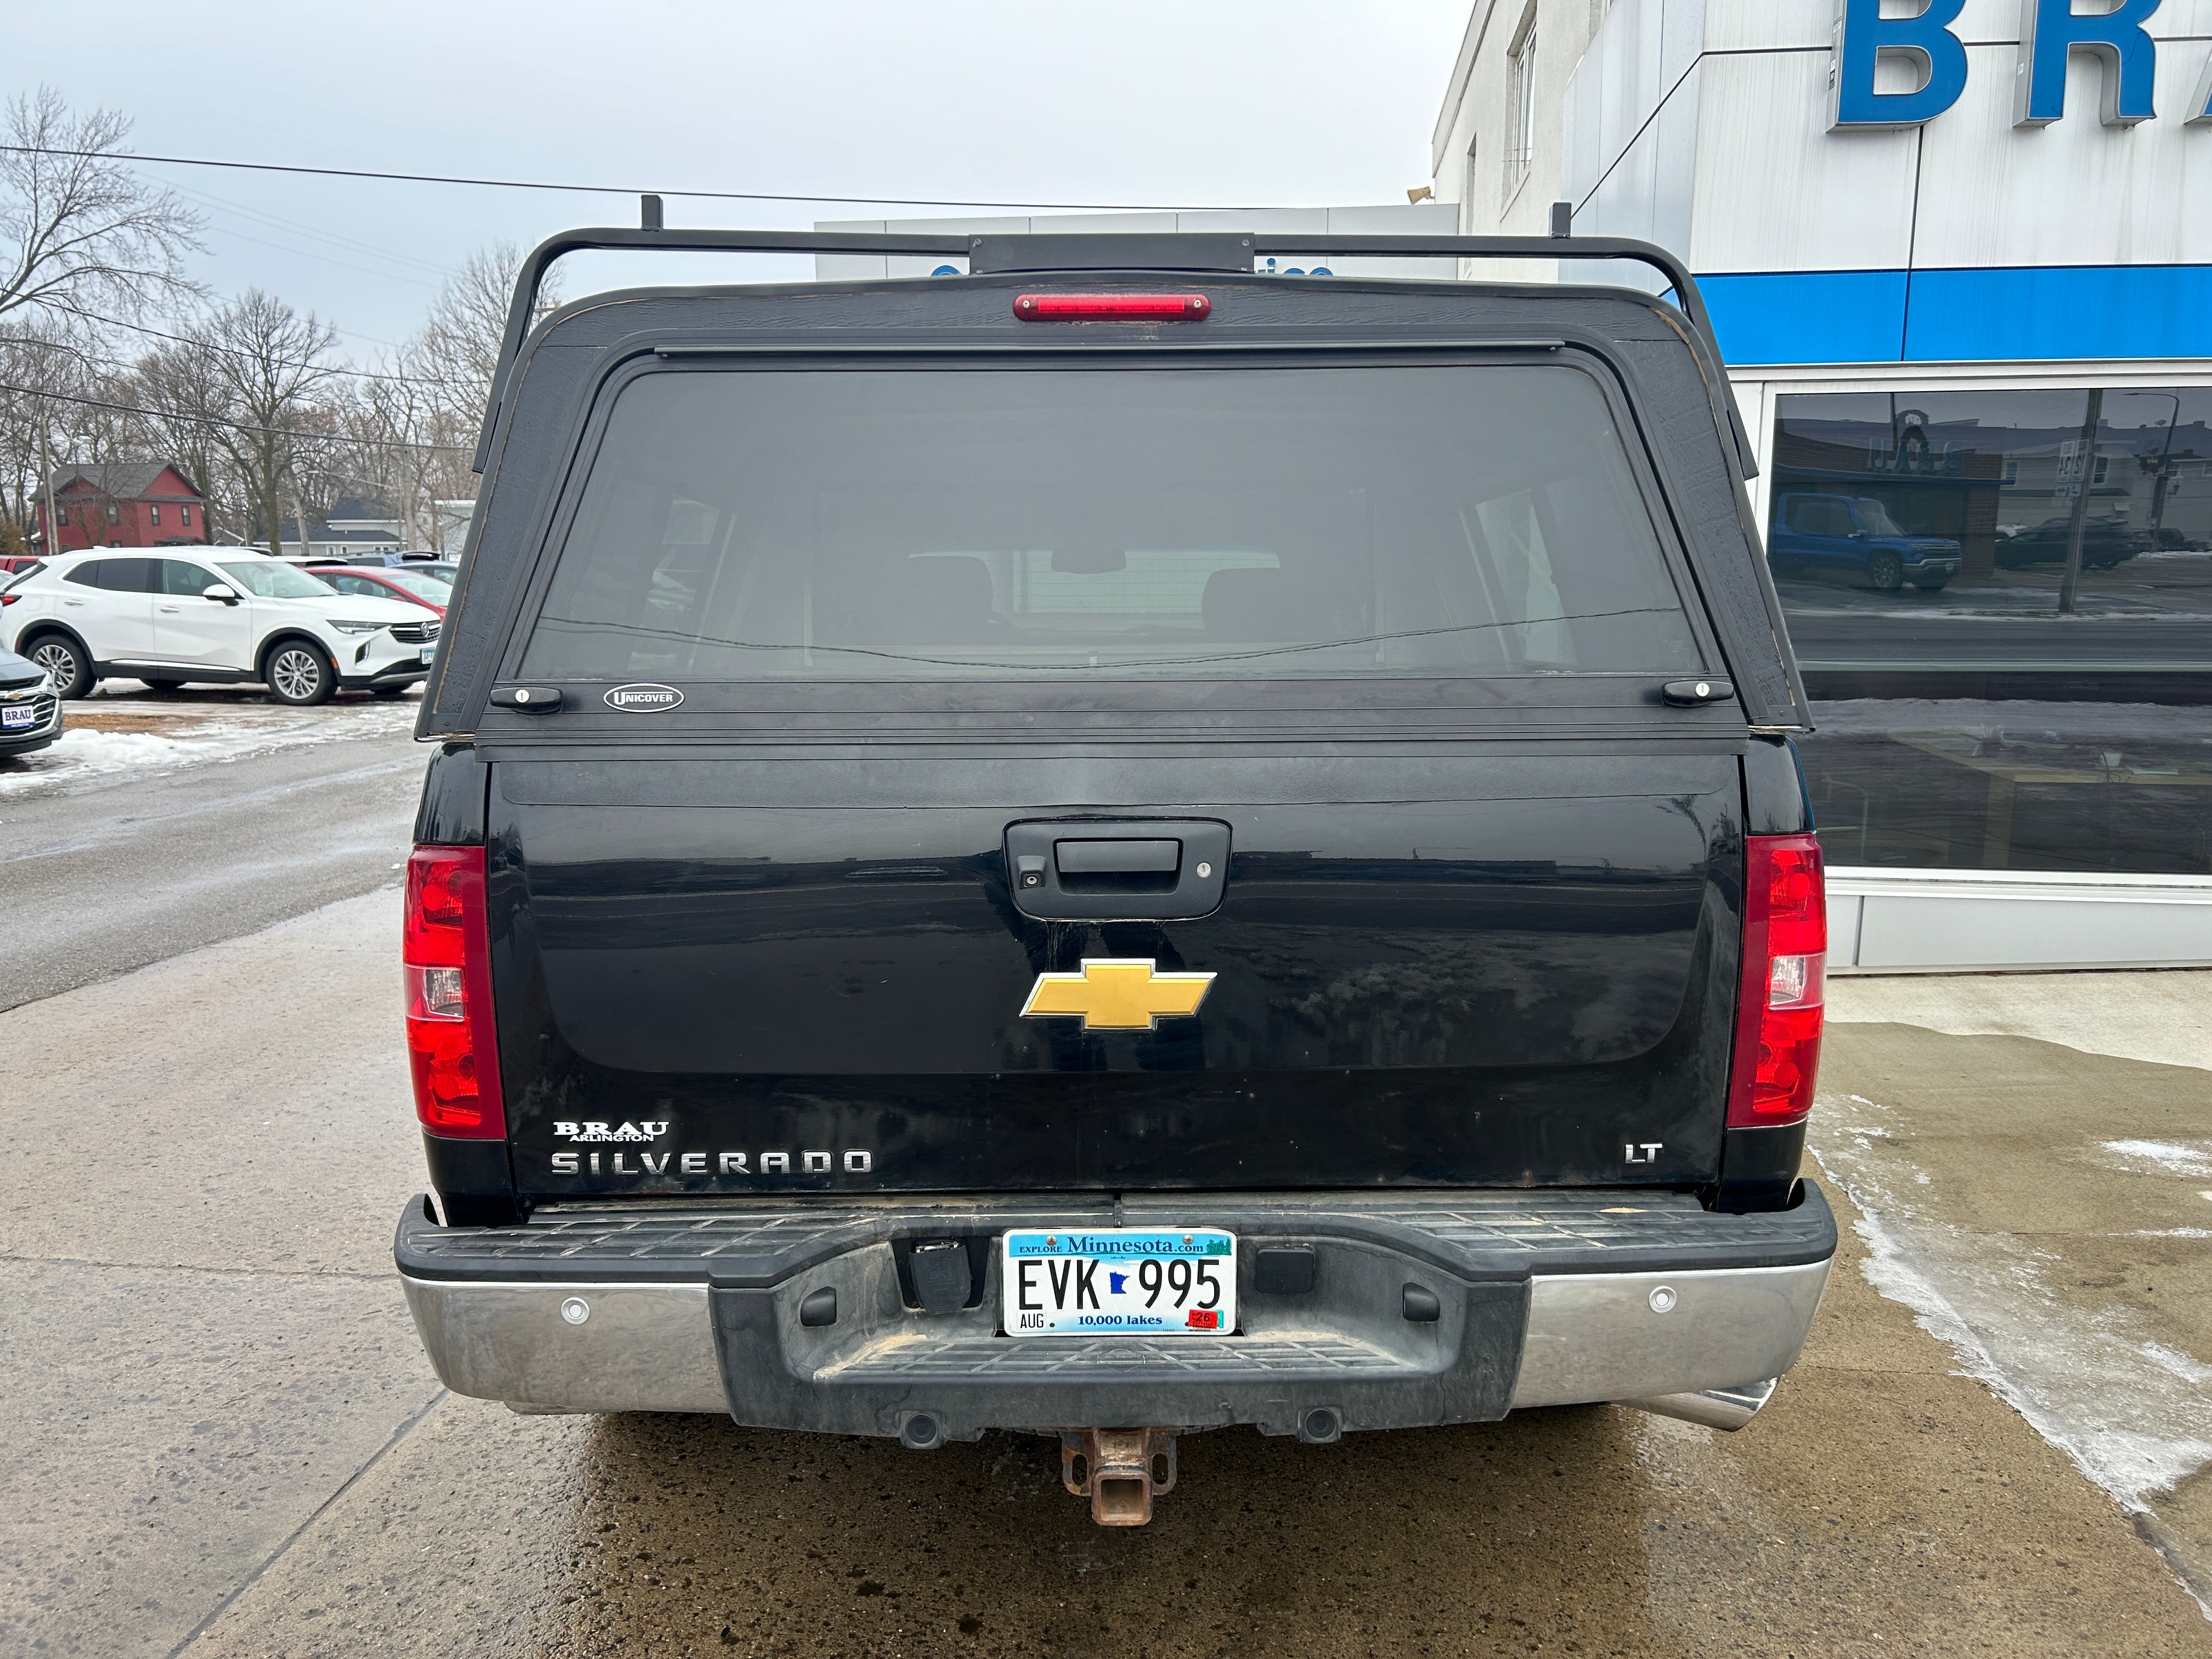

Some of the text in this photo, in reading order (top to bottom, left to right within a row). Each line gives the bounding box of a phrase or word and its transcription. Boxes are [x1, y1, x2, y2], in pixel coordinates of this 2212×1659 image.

[1827, 0, 2212, 133] BR
[614, 691, 674, 706] UNICOVER
[4, 709, 31, 721] BRAU
[553, 1121, 670, 1136] BRAU
[569, 1134, 654, 1142] ARLINGTON
[1625, 1143, 1663, 1164] LT
[551, 1151, 873, 1176] SILVERADO
[1067, 1236, 1204, 1253] Minnesota.com
[1018, 1259, 1221, 1311] EVK 995
[1019, 1313, 1044, 1329] AUG
[1077, 1314, 1163, 1326] 10,000 lakes
[1195, 1312, 1210, 1322] 26
